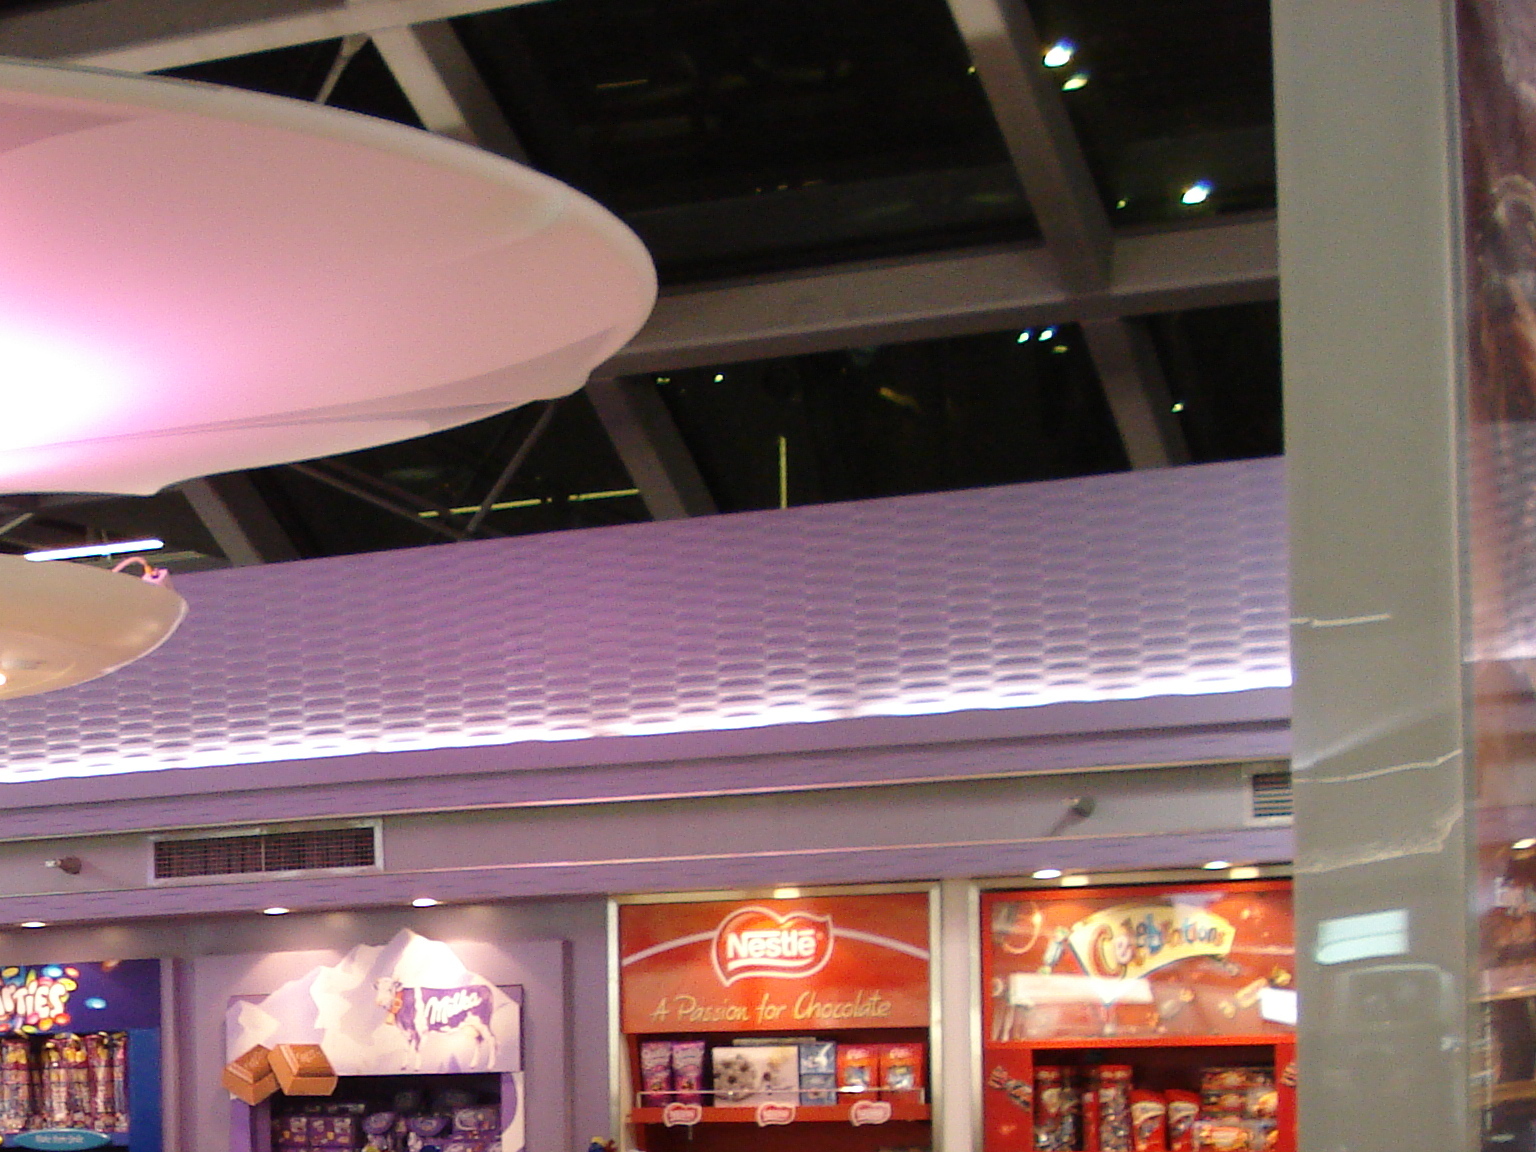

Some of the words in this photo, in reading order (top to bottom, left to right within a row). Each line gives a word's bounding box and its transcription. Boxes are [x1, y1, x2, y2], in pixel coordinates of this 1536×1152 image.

[425, 989, 482, 1024] Milka
[650, 997, 669, 1022] A
[674, 995, 749, 1023] Passion
[755, 993, 787, 1024] for
[794, 990, 892, 1021] Chocolate
